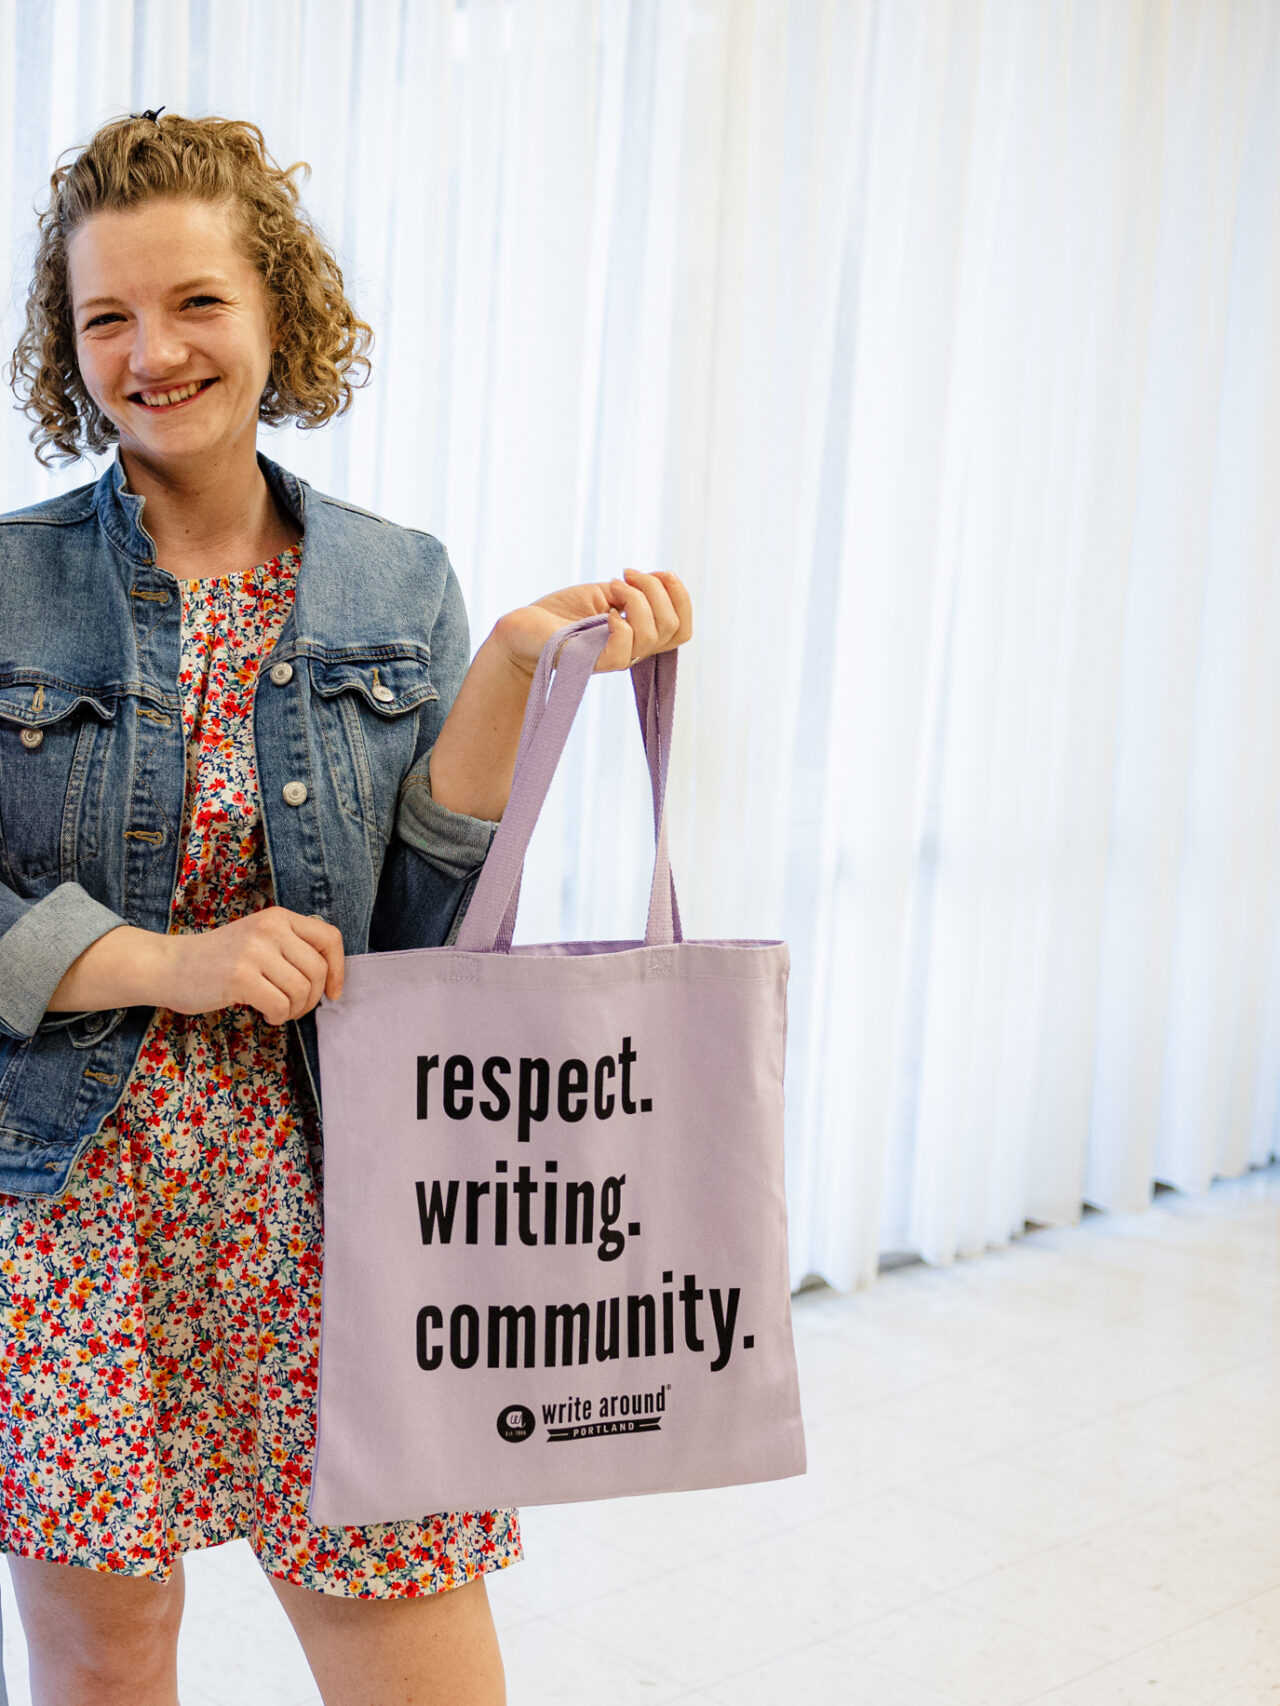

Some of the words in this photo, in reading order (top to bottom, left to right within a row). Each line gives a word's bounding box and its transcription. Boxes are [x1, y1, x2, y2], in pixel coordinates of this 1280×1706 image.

[416, 1036, 653, 1143] respect.
[415, 1160, 641, 1262] writing.
[415, 1270, 755, 1372] community.
[542, 1396, 592, 1425] write
[573, 1422, 635, 1437] PORTLAND
